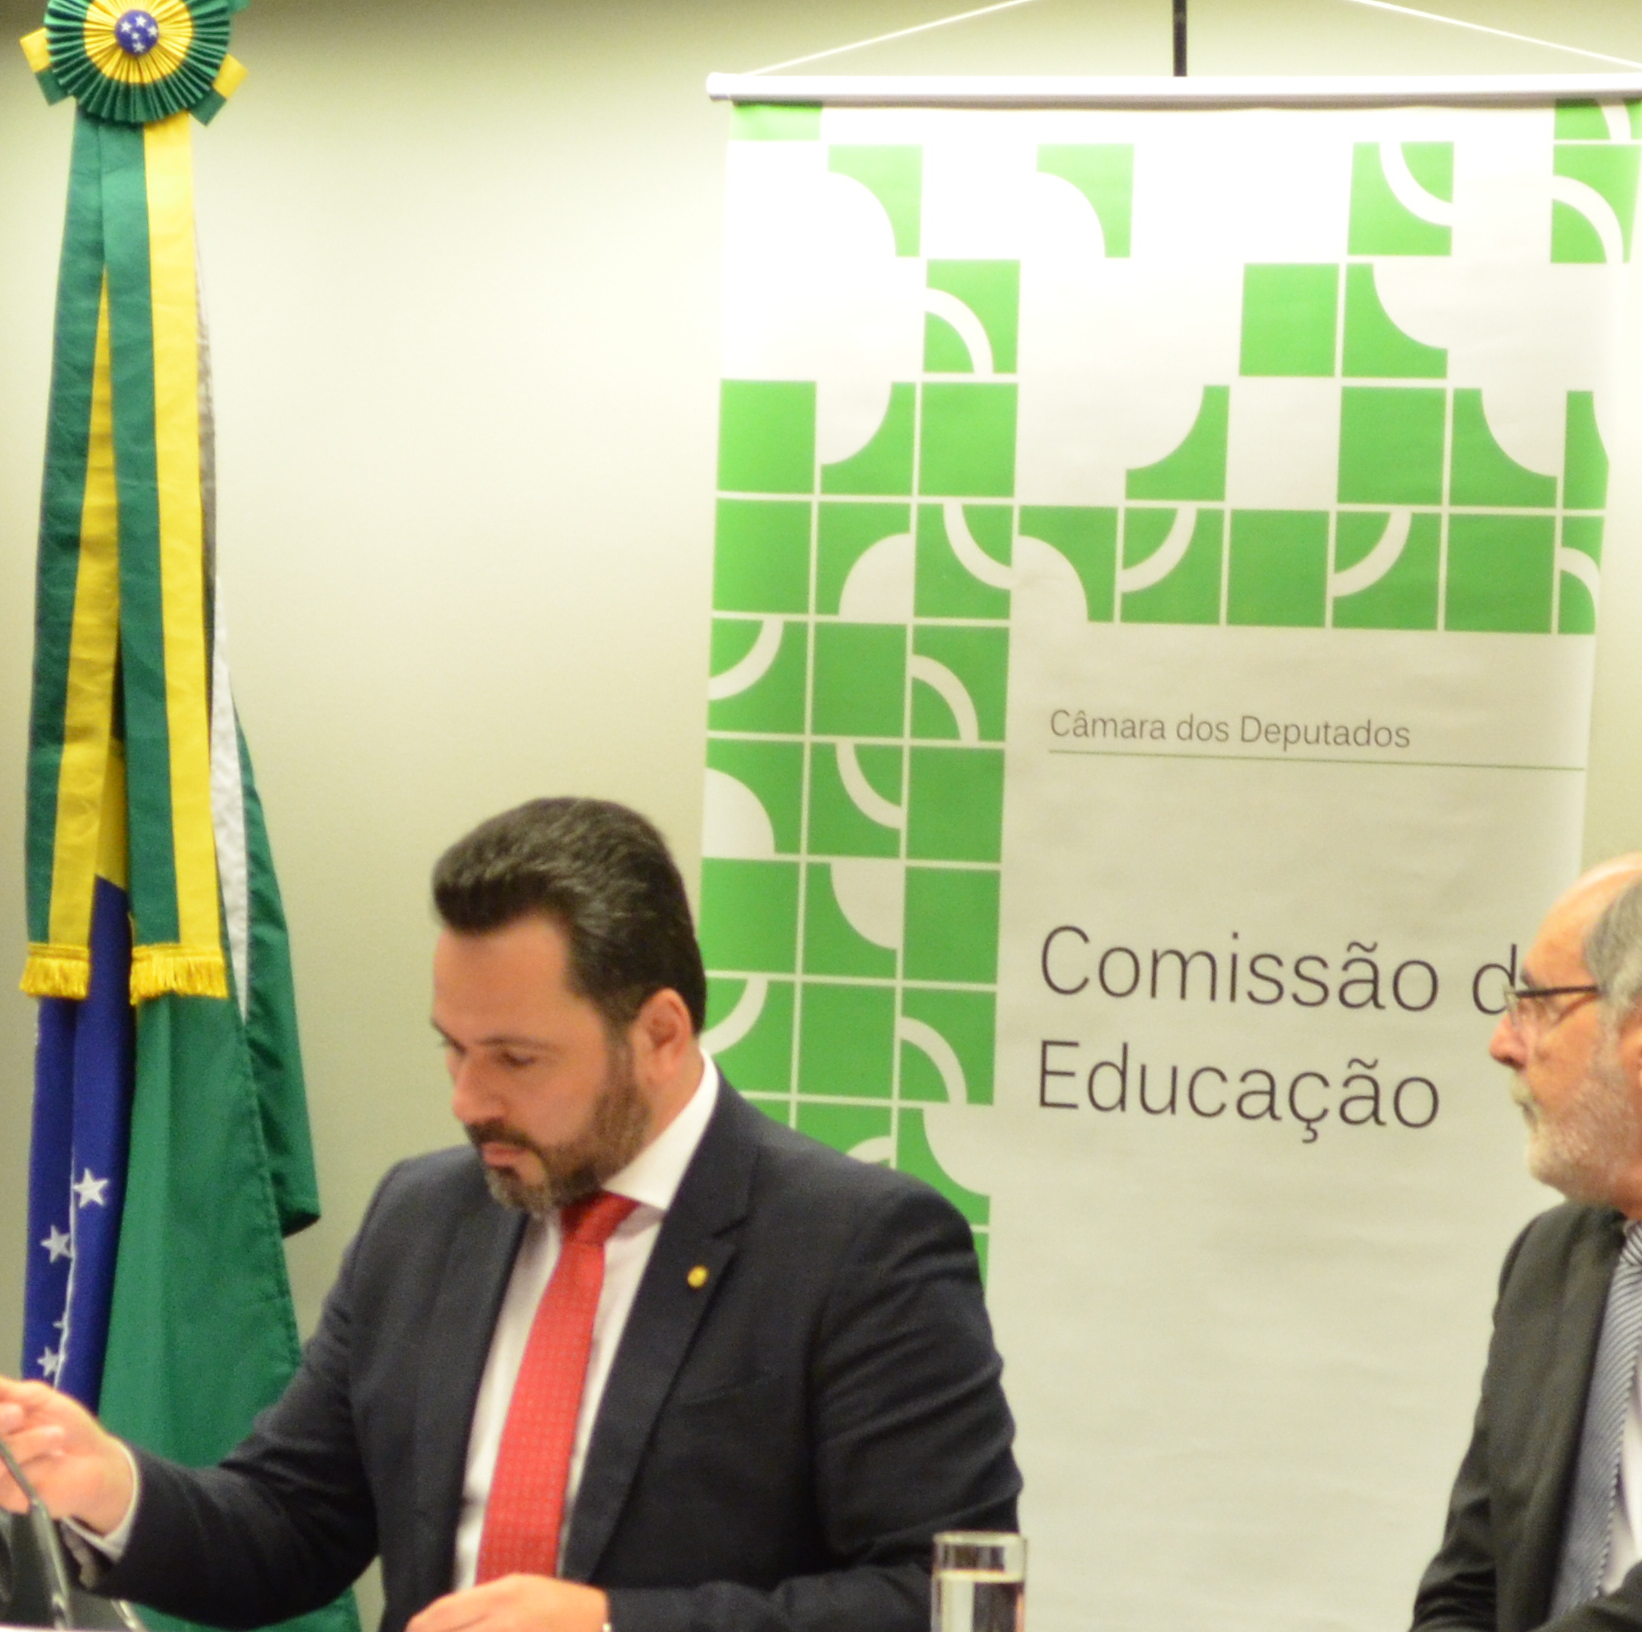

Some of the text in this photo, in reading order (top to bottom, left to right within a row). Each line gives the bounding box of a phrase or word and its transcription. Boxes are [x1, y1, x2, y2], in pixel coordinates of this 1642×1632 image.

[1050, 709, 1411, 753] Câmara dos Deputados
[1040, 924, 1440, 1013] Comissão
[1038, 1038, 1440, 1145] Educação
